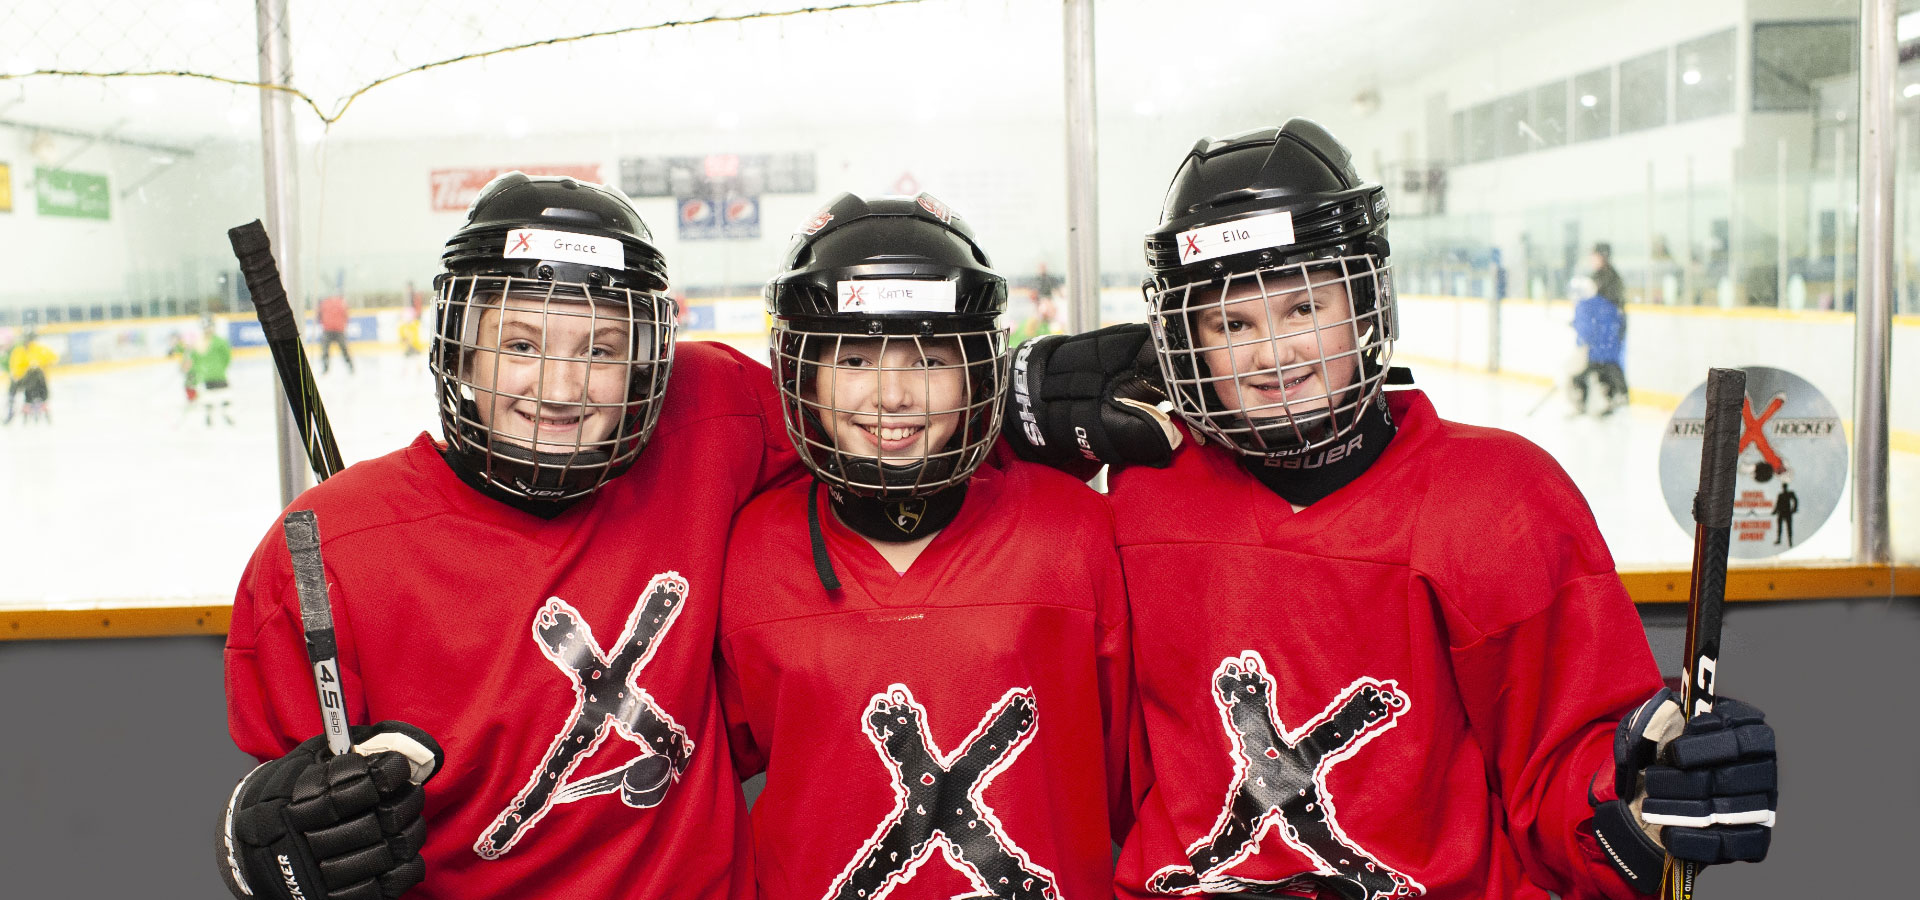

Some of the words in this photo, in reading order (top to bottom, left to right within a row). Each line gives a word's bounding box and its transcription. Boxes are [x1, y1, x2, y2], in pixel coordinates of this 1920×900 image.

[553, 238, 598, 254] Grace
[1222, 229, 1251, 243] Ella
[878, 286, 914, 300] KATIE
[1263, 433, 1364, 470] BAUER
[320, 664, 340, 709] 4.5
[1684, 861, 1694, 892] CDAVID
